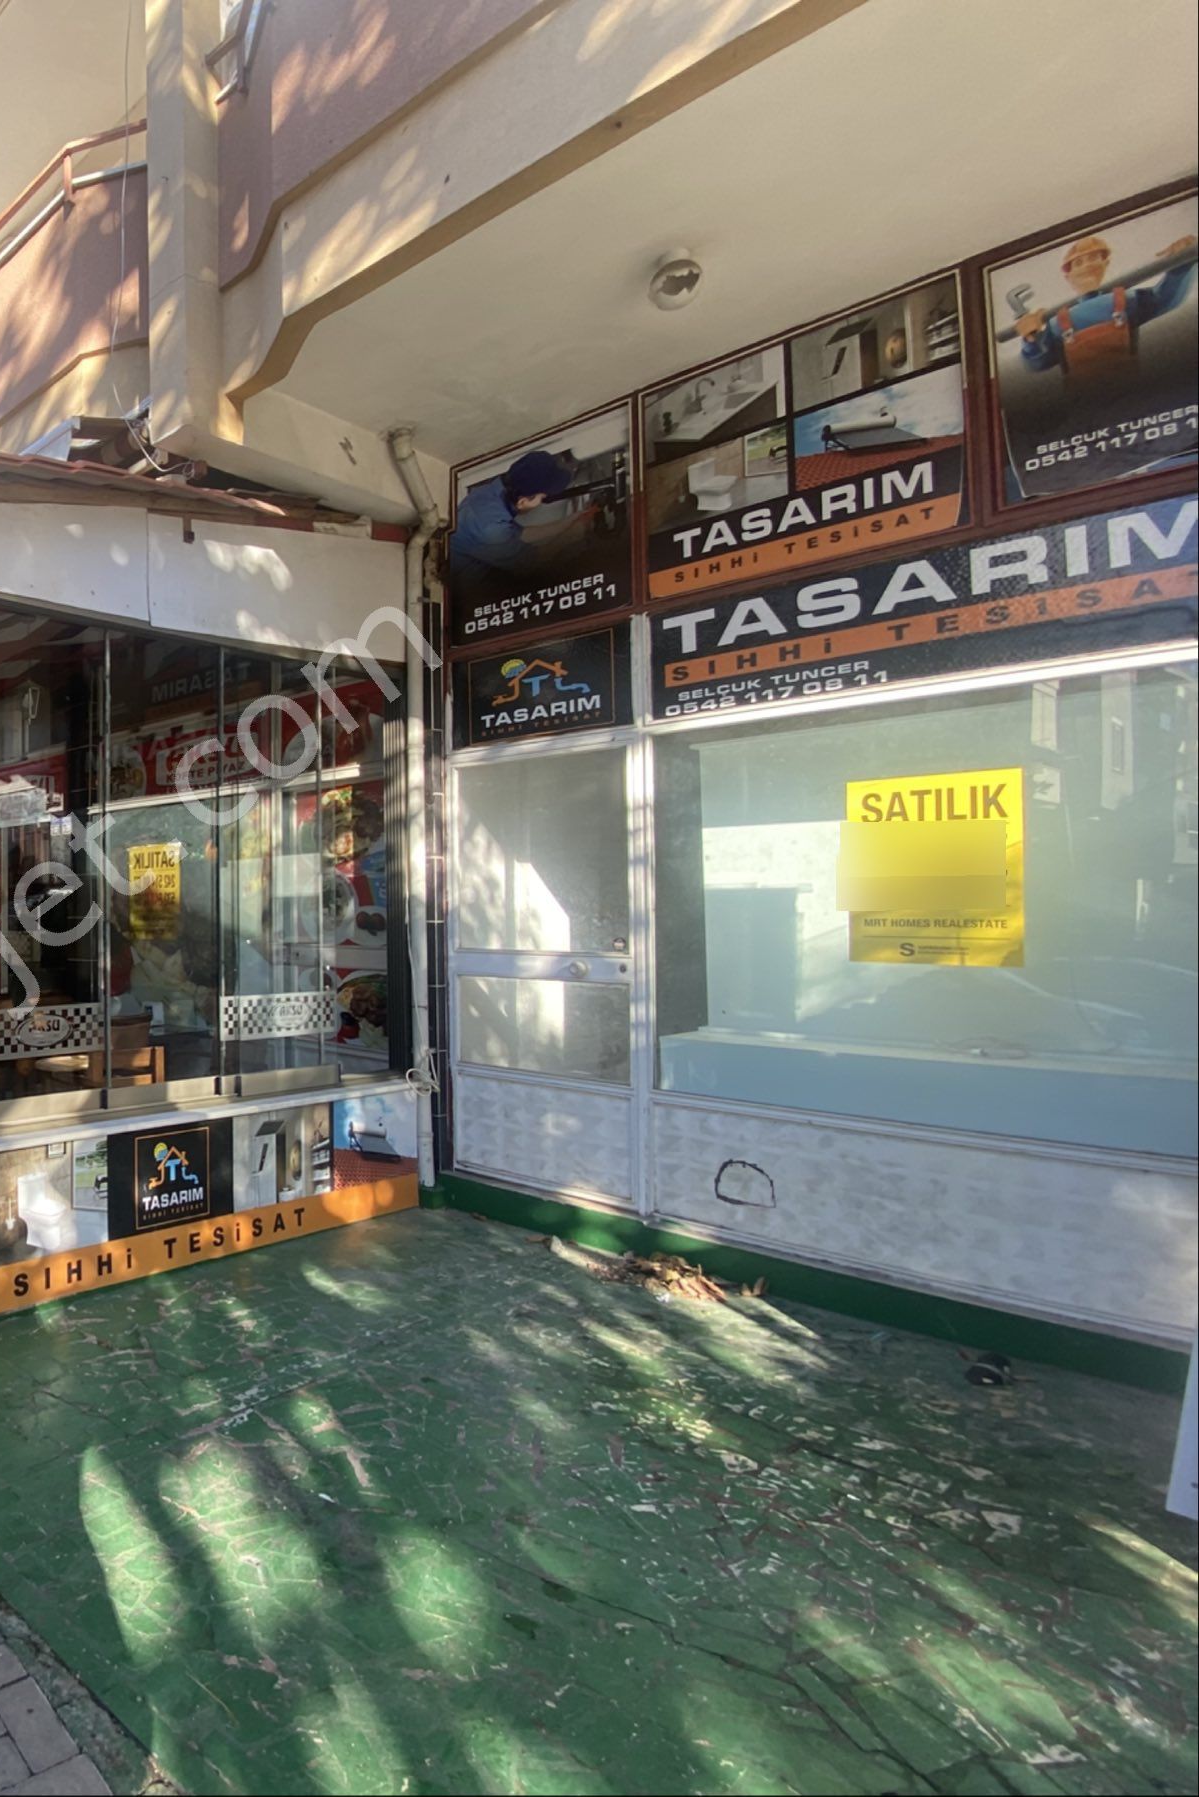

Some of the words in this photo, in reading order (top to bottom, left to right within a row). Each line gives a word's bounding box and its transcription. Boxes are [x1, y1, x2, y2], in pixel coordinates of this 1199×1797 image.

[1025, 446, 1088, 471] 0542
[1096, 434, 1138, 452] 117
[1144, 420, 1177, 442] 08
[1037, 427, 1109, 454] SELÇUK
[1117, 404, 1198, 433] TUNCER
[673, 461, 934, 558] TASARIM
[474, 593, 532, 618] SELÇUK
[537, 573, 604, 600] TUNCER
[662, 500, 1198, 654] TASARIM
[465, 611, 514, 634] 0542
[519, 600, 554, 619] 117
[559, 592, 586, 610] 08
[593, 584, 617, 600] 11
[886, 570, 1198, 641] TESiSA
[665, 694, 737, 717] 0542
[744, 686, 795, 703] 117
[802, 678, 843, 695] 08
[854, 670, 888, 685] 11
[678, 678, 761, 702] SELÇUK
[770, 660, 870, 686] TUNCER
[481, 694, 601, 729] TASARIM
[861, 783, 1009, 823] SATILIK
[891, 918, 931, 928] HOMES
[934, 918, 1008, 929] REALESTATE
[142, 1186, 204, 1211] TASARIM
